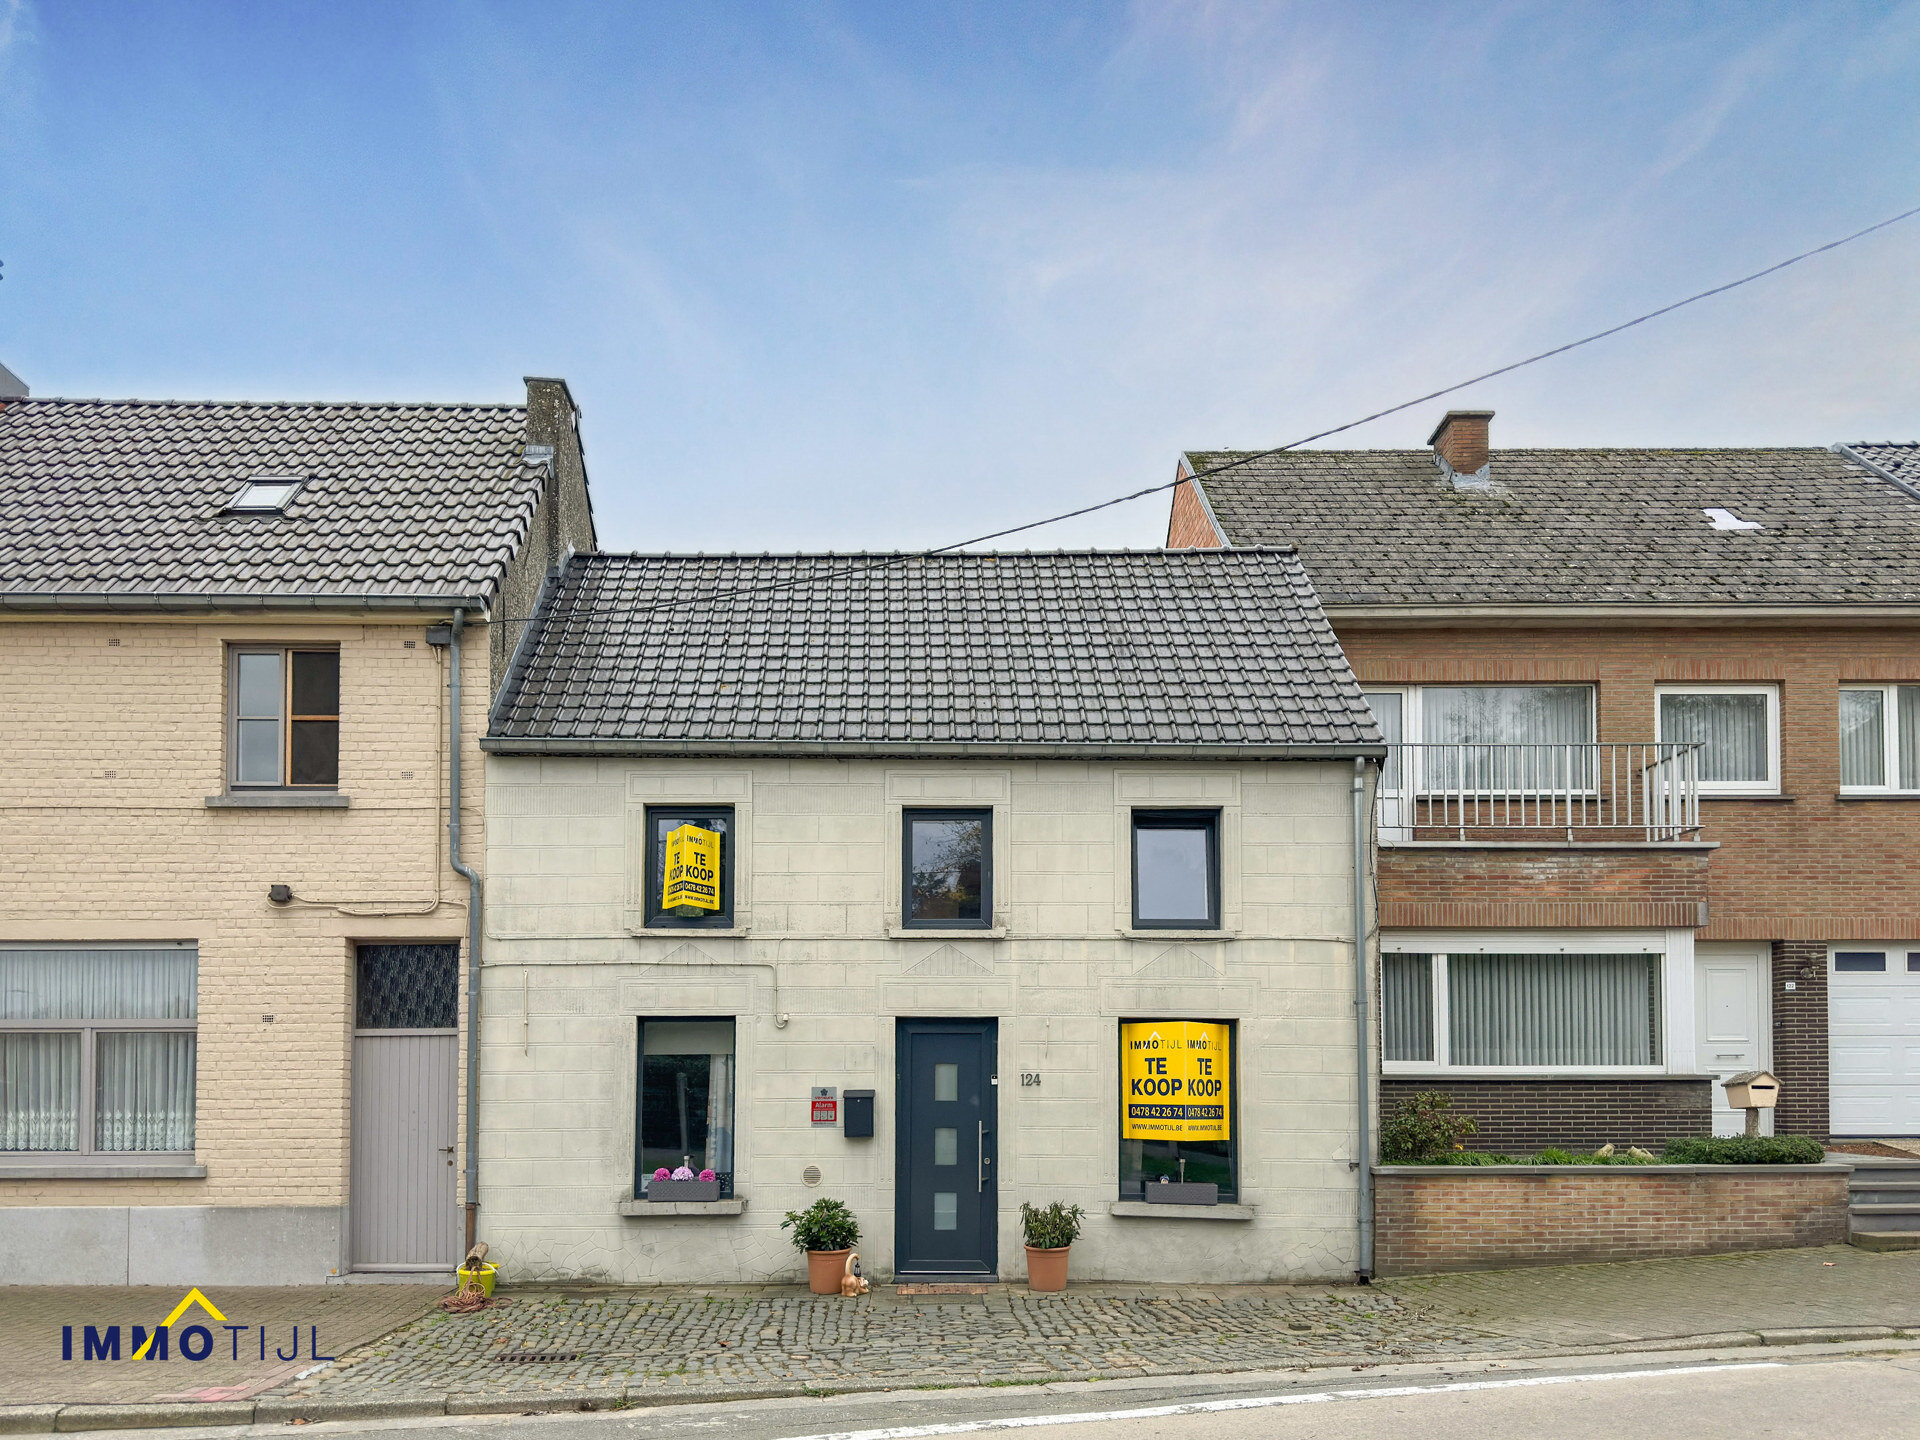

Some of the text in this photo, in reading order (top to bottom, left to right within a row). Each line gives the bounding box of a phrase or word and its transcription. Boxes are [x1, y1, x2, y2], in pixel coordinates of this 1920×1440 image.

[693, 852, 706, 866] TE
[686, 865, 714, 882] KOOP
[1130, 1040, 1182, 1050] IMMOTIJL
[1187, 1040, 1221, 1051] IMMOTIJL
[1145, 1057, 1167, 1075] TE
[1197, 1058, 1212, 1075] TE
[1020, 1073, 1041, 1086] 124
[1131, 1078, 1183, 1096] KOOP
[1188, 1078, 1221, 1097] KOOP
[1131, 1107, 1183, 1117] 0478 42 26 74
[1187, 1107, 1222, 1117] 0478 42 26 74
[1131, 1123, 1183, 1131] WWW.IMMOTIJL.BE
